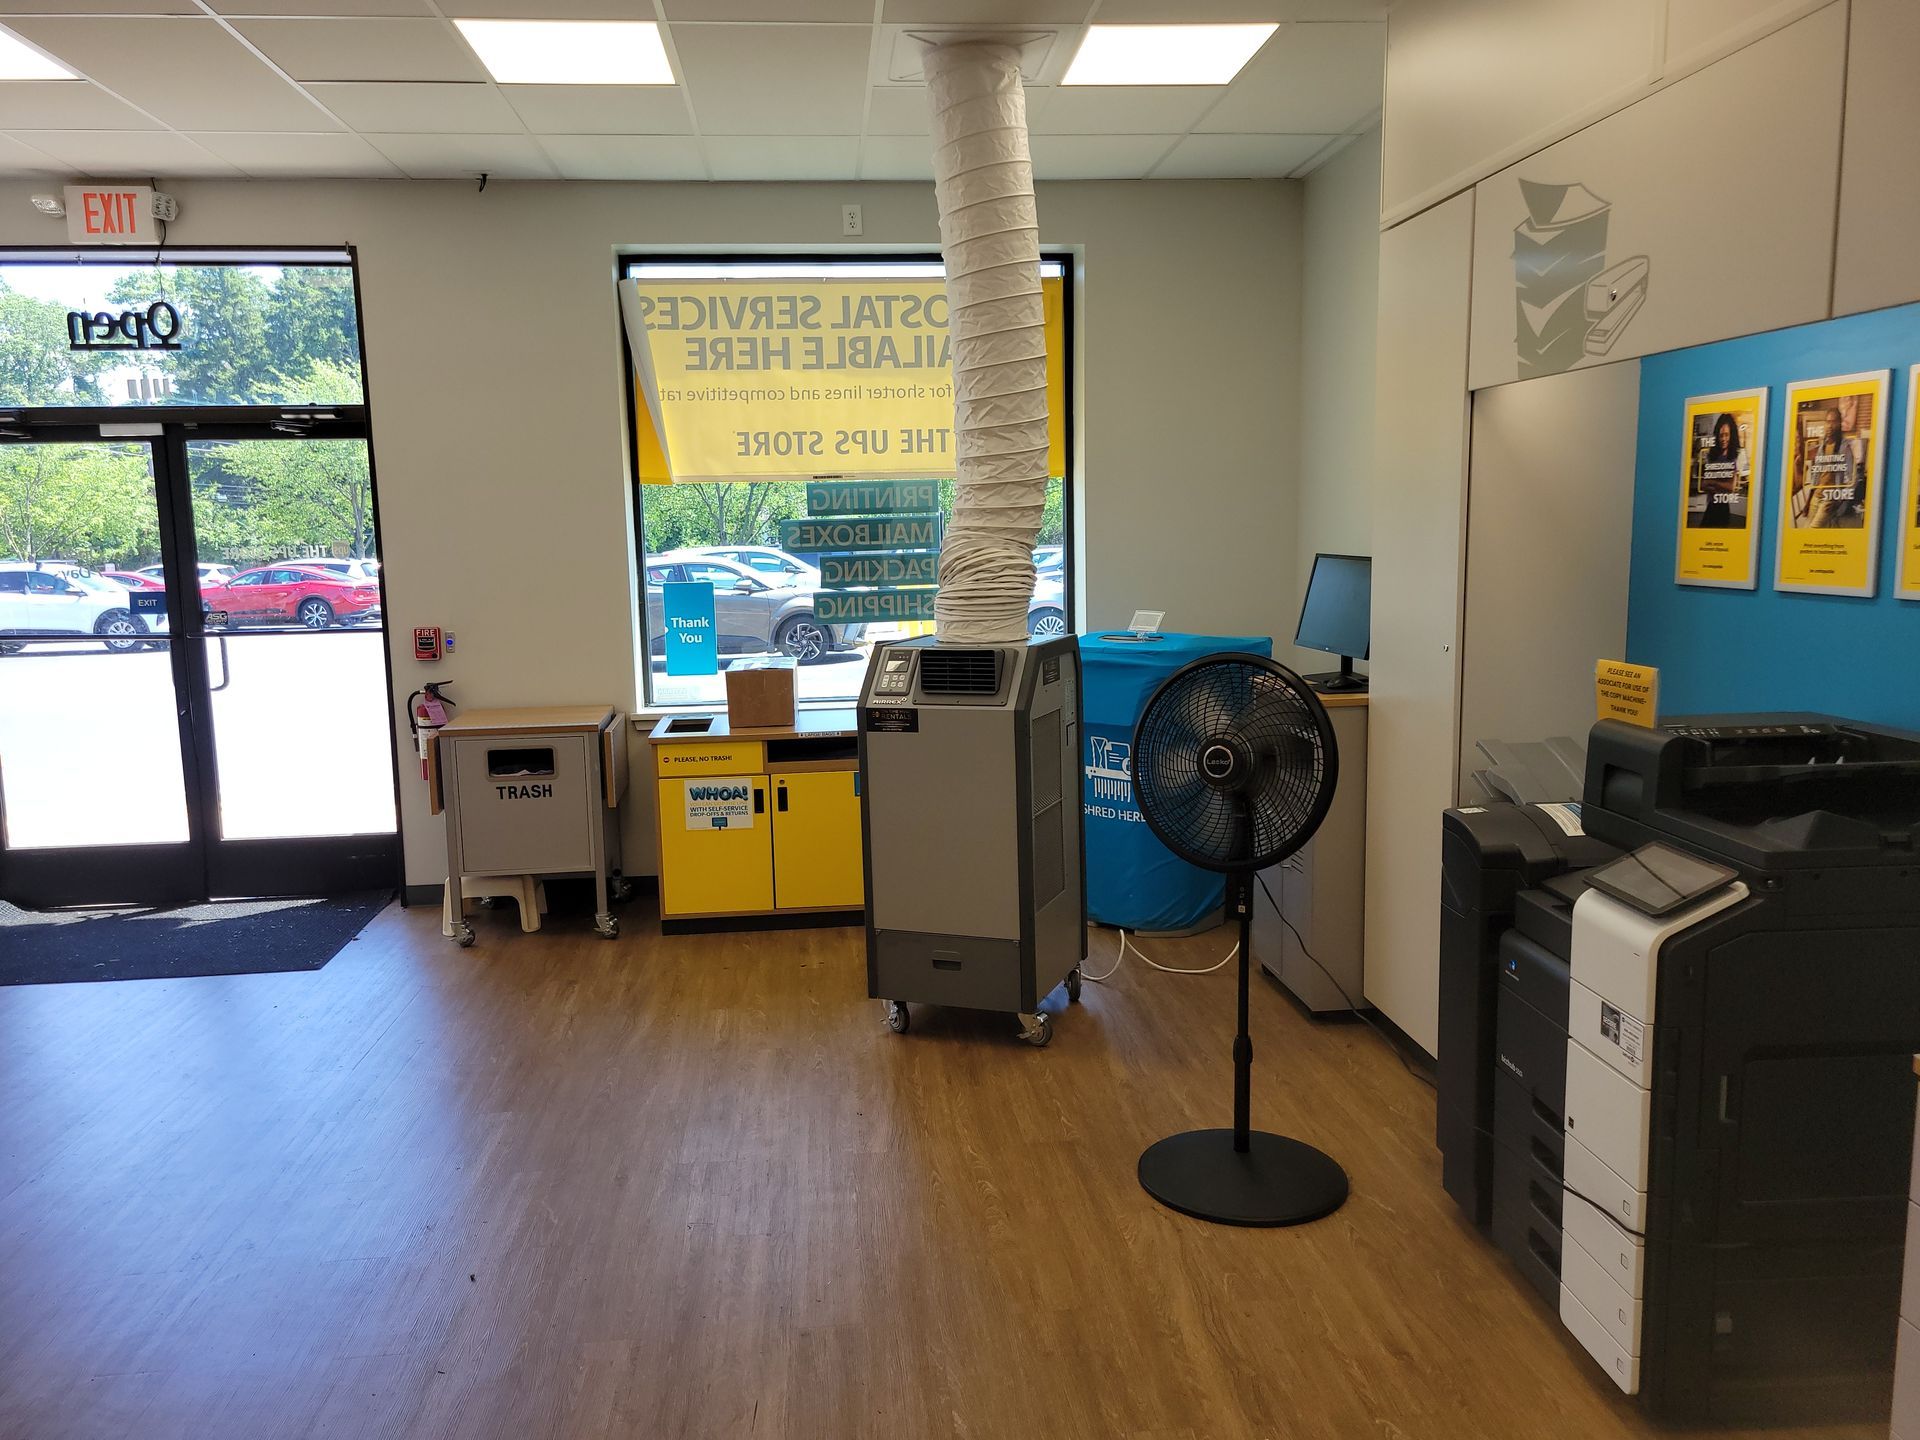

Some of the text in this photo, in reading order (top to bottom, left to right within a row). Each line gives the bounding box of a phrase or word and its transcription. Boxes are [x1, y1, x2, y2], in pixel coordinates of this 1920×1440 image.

[82, 193, 137, 234] EXIT
[1806, 426, 1824, 438] THE
[1701, 436, 1716, 448] THE
[1815, 454, 1845, 464] PRINTING
[1811, 464, 1847, 473] SOLUTIONS
[1703, 470, 1734, 480] SOLUTIONS
[1713, 493, 1740, 505] STORE
[1822, 488, 1854, 501] STORE
[138, 599, 158, 607] EXIT
[207, 613, 228, 621] ASG
[670, 616, 710, 629] Thank
[416, 629, 435, 637] FIRE
[679, 632, 703, 643] You
[1607, 667, 1624, 676] PLEASE
[1625, 670, 1634, 679] SEE
[1597, 678, 1622, 688] ASSOCIATE
[1622, 682, 1632, 690] FOR
[1601, 689, 1609, 697] THE
[1610, 691, 1622, 699] COPY
[1610, 704, 1626, 713] THANK
[496, 783, 553, 800] TRASH
[689, 786, 749, 801] WHOA!
